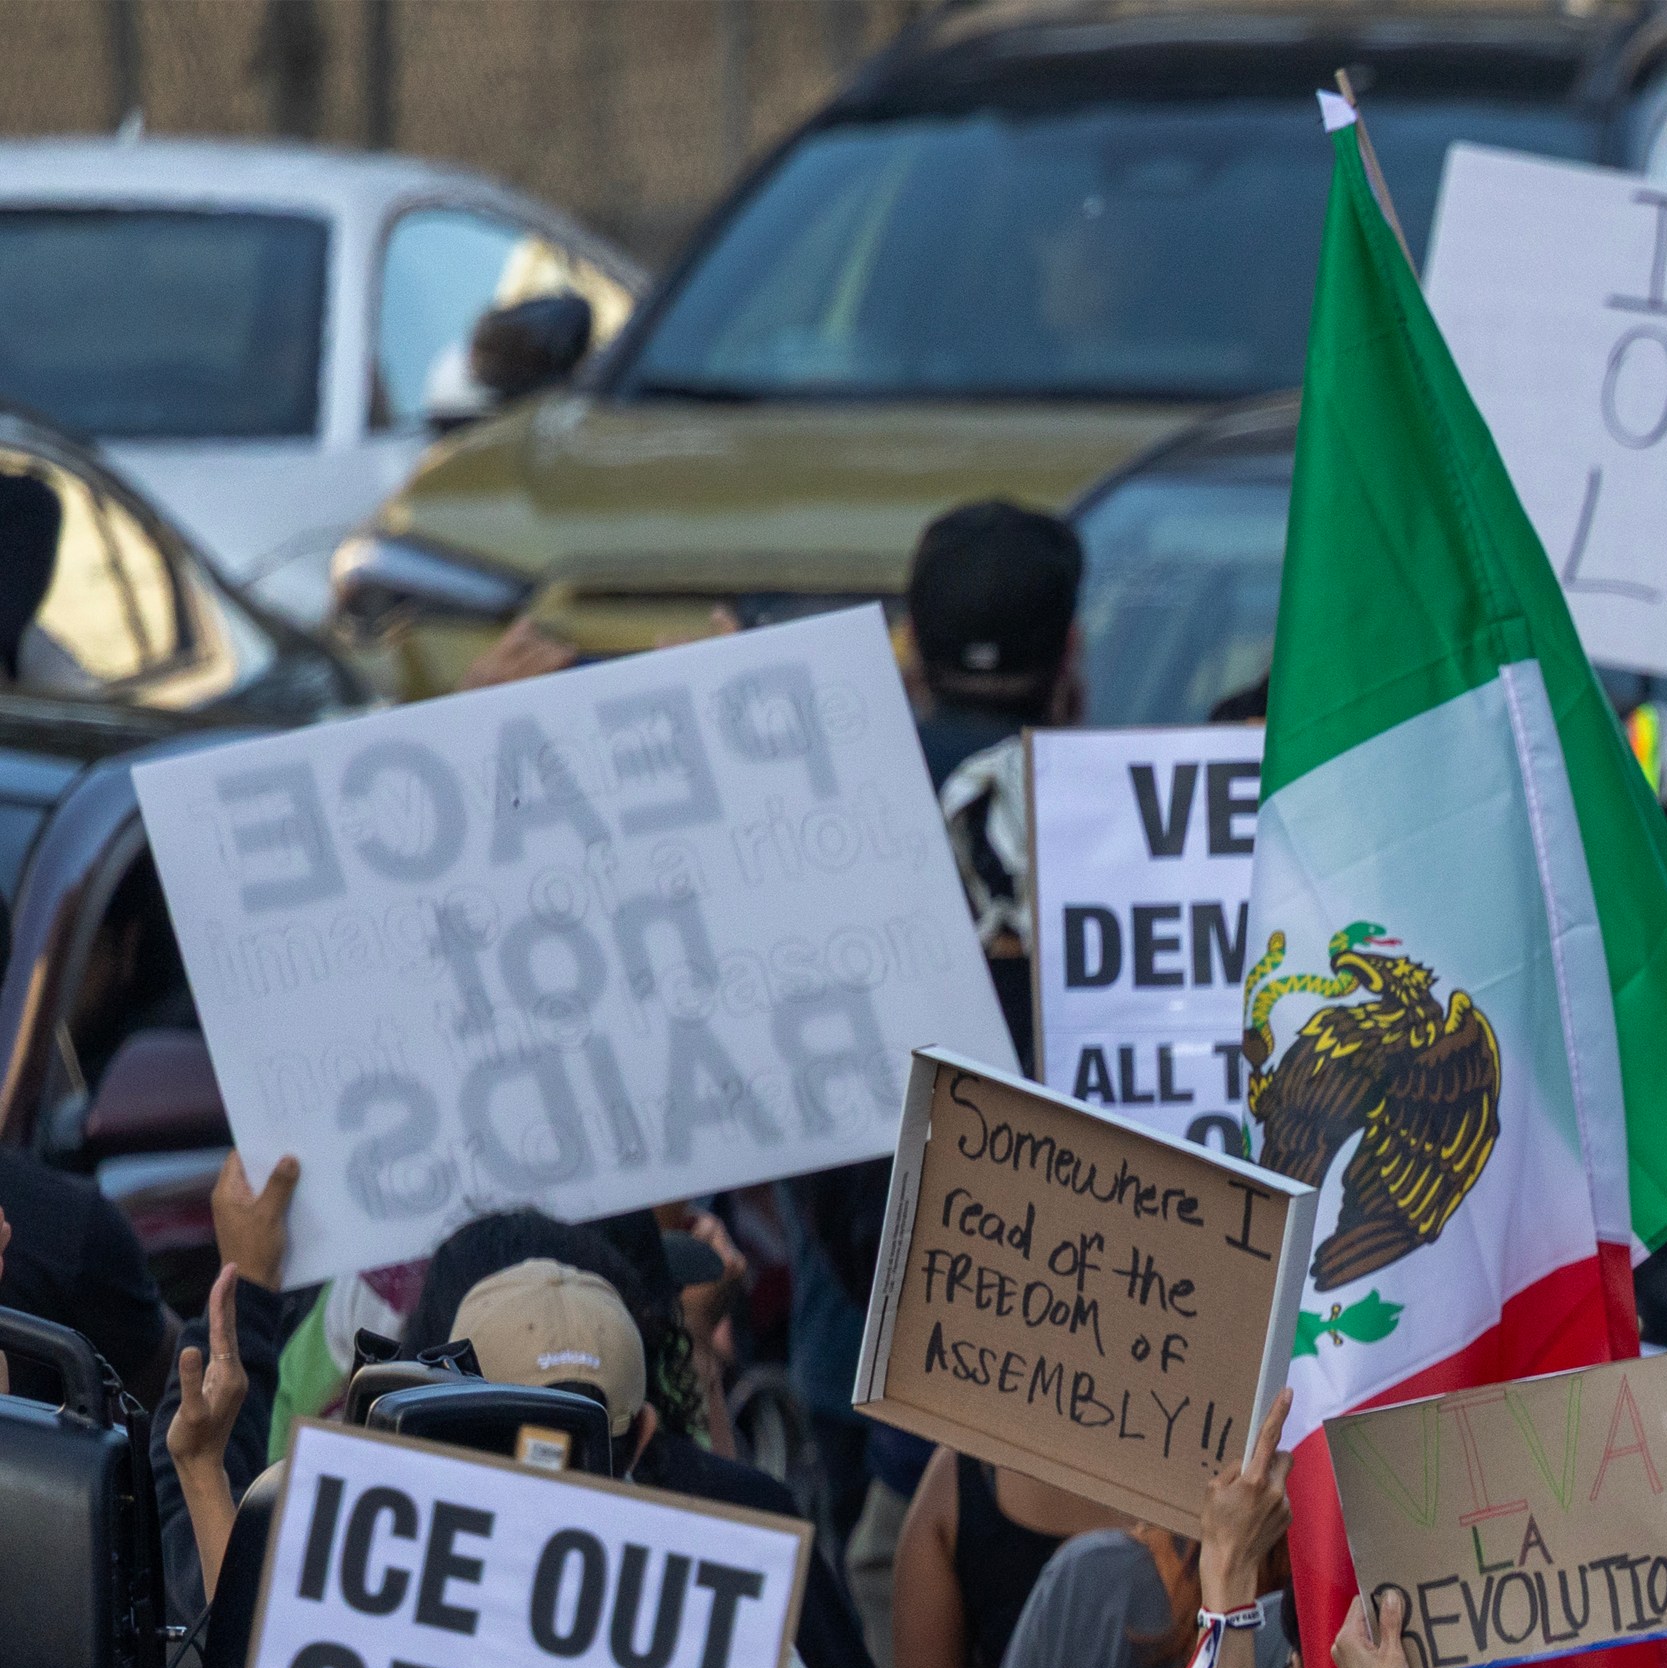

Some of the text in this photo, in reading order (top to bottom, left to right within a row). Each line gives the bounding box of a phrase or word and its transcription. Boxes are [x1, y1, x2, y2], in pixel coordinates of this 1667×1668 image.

[1129, 759, 1262, 859] VE
[1063, 901, 1247, 990] DEM
[1073, 1044, 1196, 1106] ALL
[950, 1072, 1204, 1227] Somewhere
[1225, 1179, 1272, 1261] I
[921, 1249, 1105, 1356] FREEDOM
[942, 1188, 1034, 1260] read
[1113, 1246, 1197, 1316] the
[1339, 1373, 1664, 1528] VIVA
[297, 1475, 497, 1637] ICE
[1470, 1513, 1554, 1576] LA
